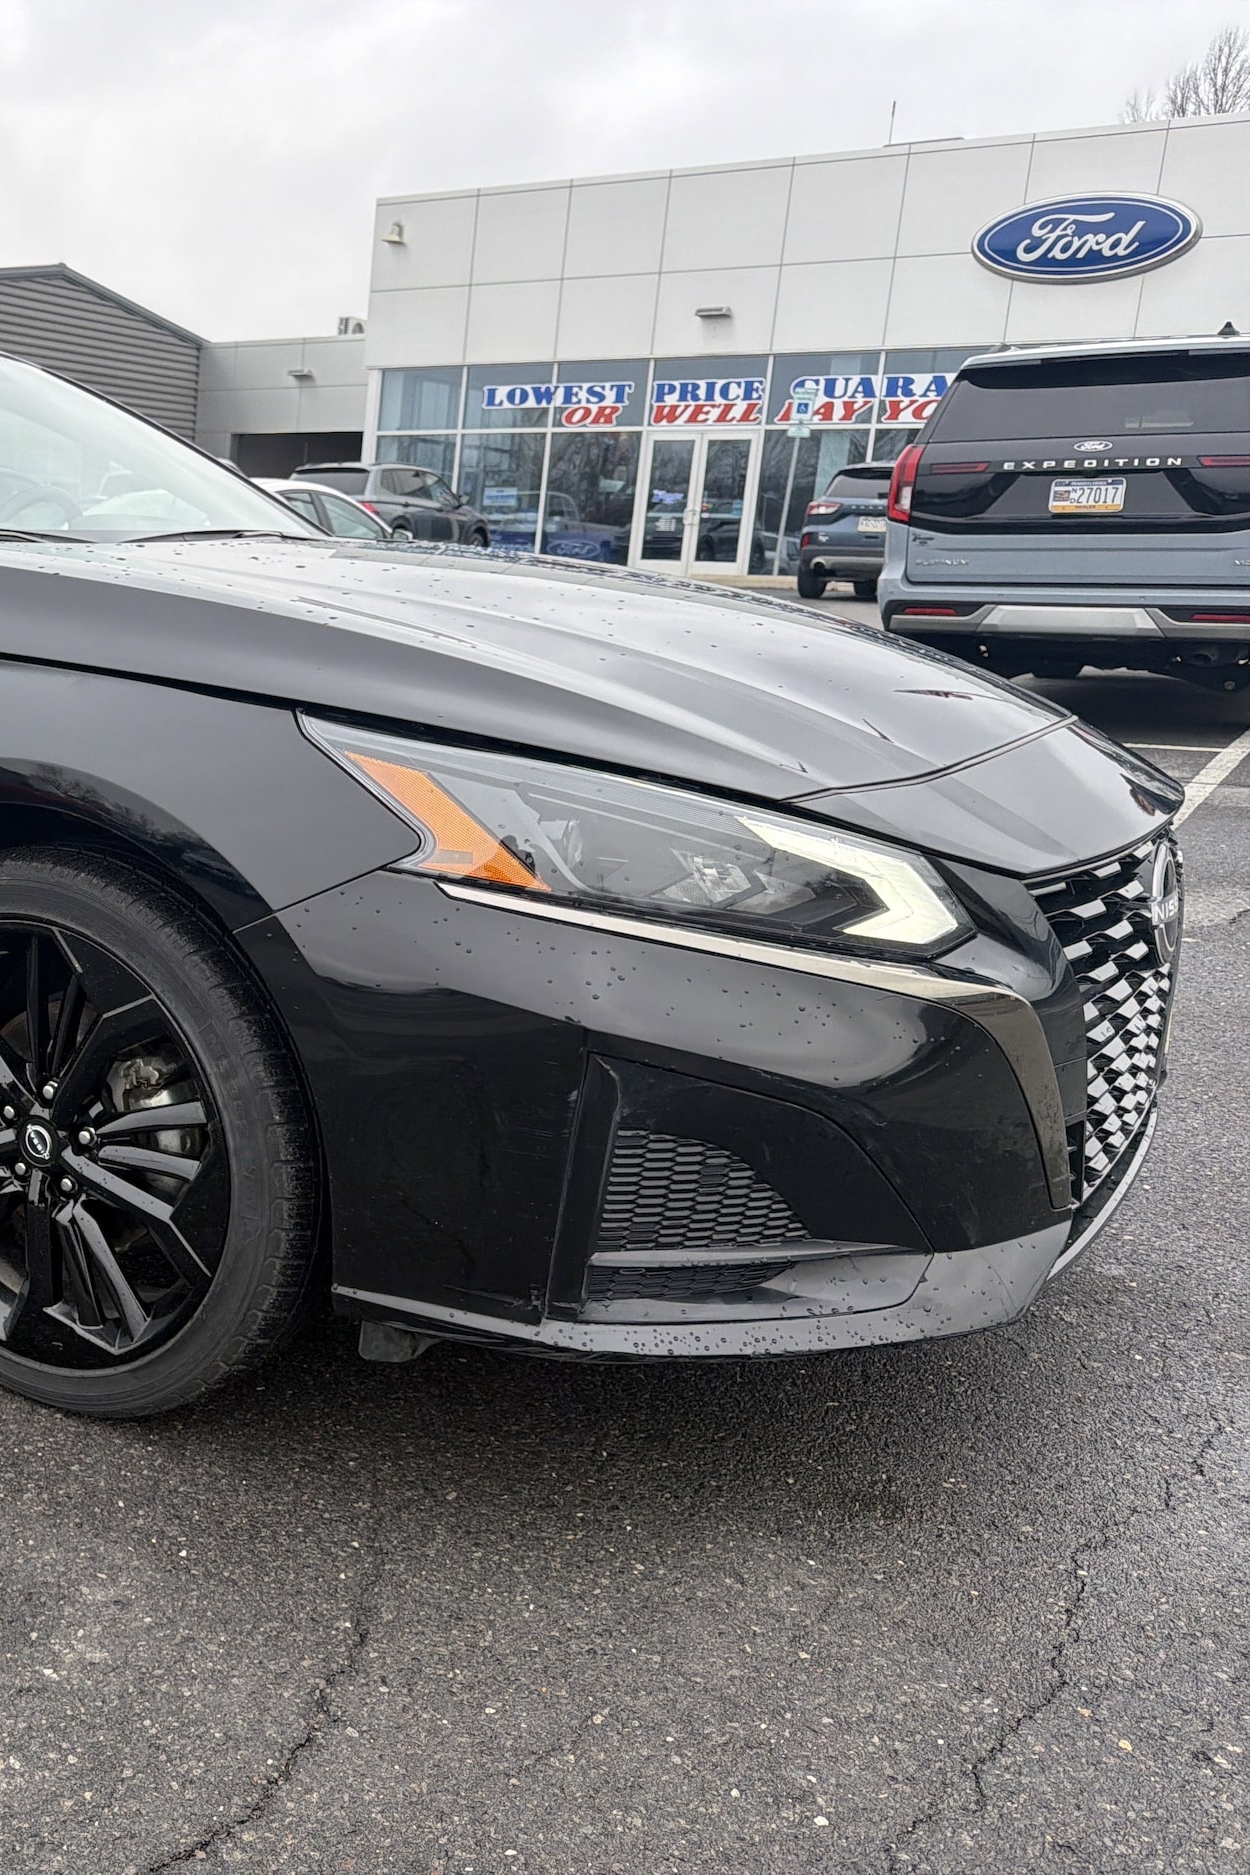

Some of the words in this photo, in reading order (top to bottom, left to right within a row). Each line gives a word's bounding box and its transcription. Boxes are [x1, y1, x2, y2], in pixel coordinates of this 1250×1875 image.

[1016, 211, 1147, 262] Ford
[485, 383, 632, 407] LOWEST
[653, 380, 764, 403] PRICE
[563, 405, 621, 425] OR
[1002, 457, 1183, 470] EXPEDITION
[1076, 487, 1120, 504] 27017
